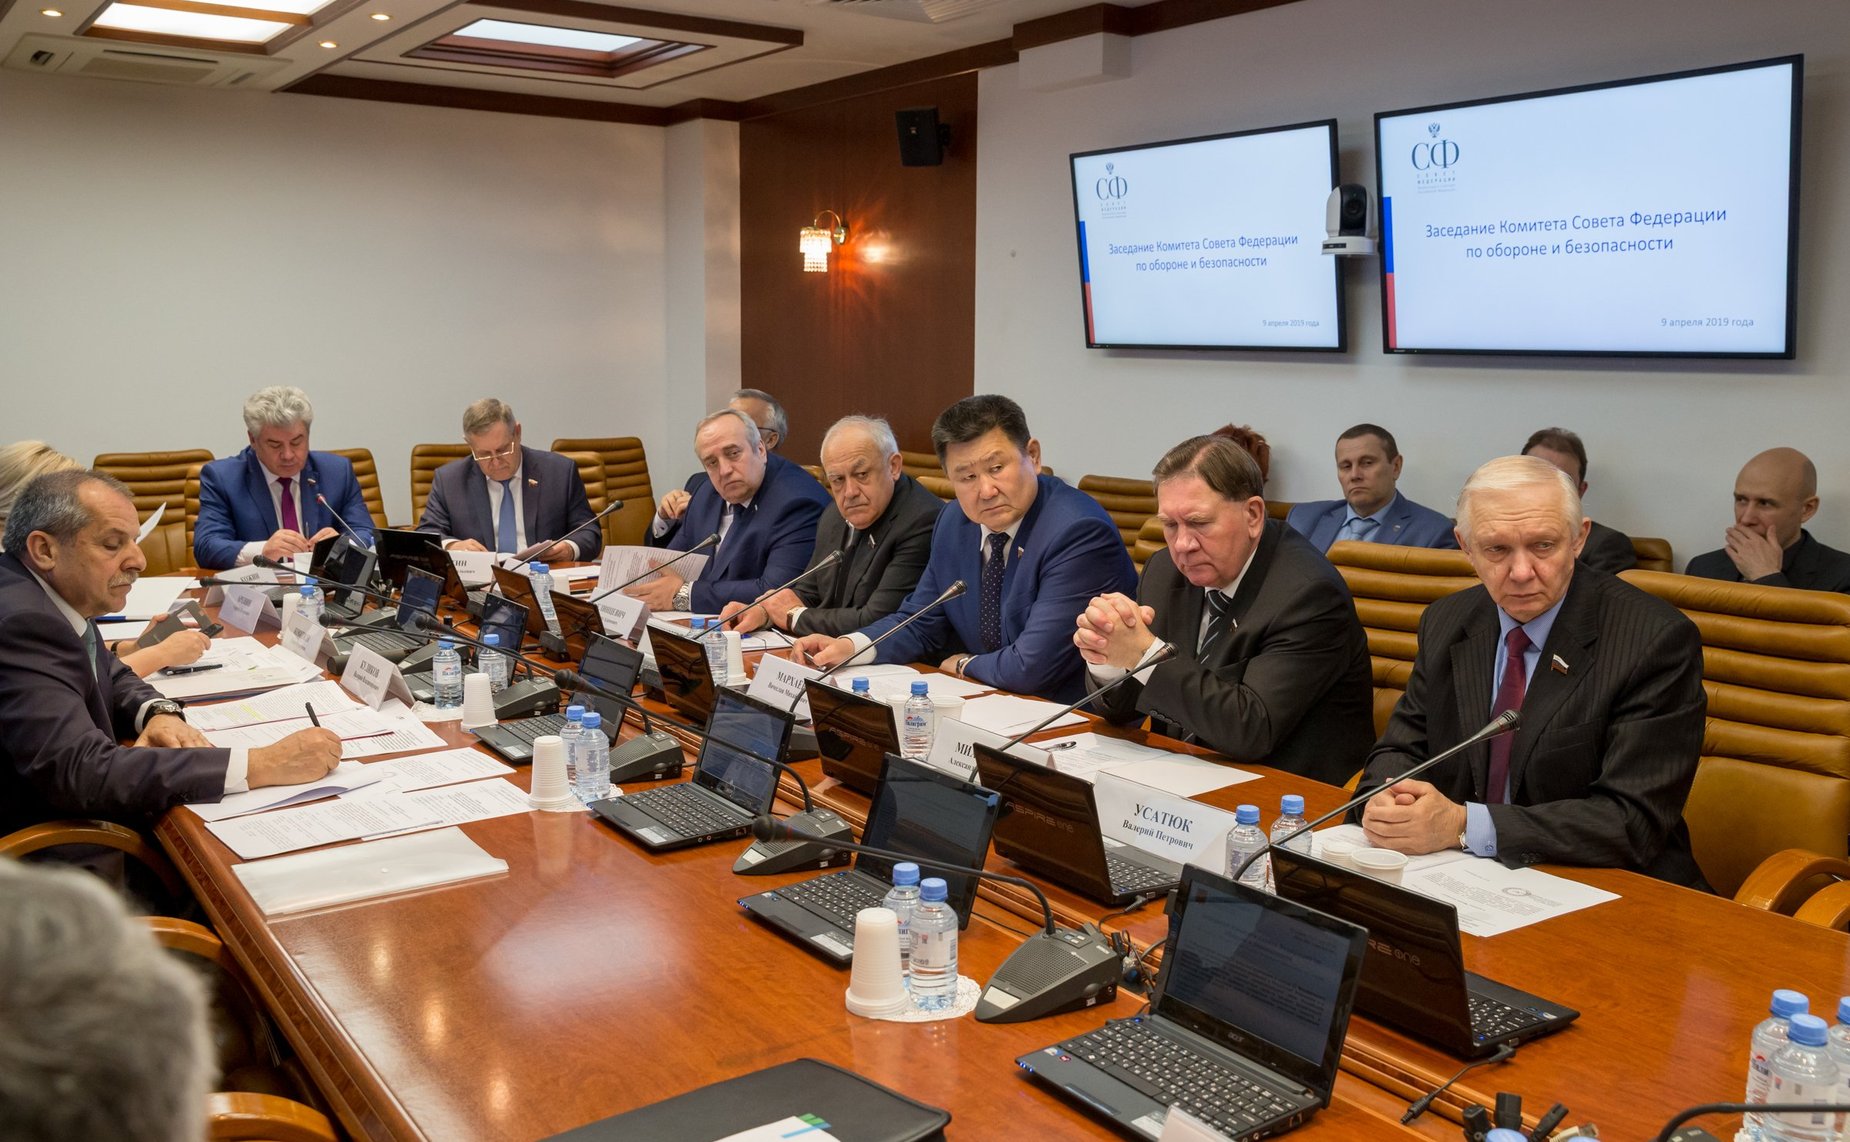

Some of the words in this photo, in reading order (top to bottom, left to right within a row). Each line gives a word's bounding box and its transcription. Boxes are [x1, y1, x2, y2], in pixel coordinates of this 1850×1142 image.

[1411, 139, 1460, 170] СФ
[1096, 176, 1128, 200] СФ
[1426, 223, 1496, 239] Заседание
[1499, 219, 1567, 234] Комитета
[1572, 215, 1625, 230] Совета
[1630, 209, 1727, 228] Федерации
[1108, 243, 1155, 255] Заседание
[1156, 240, 1200, 252] Комитета
[1202, 237, 1236, 250] Совета
[1238, 235, 1298, 249] Федерации
[1466, 247, 1482, 258] по
[1486, 242, 1547, 259] обороне
[1552, 244, 1560, 254] и
[1565, 238, 1673, 254] безопасности
[1136, 261, 1147, 272] по
[1149, 258, 1189, 272] обороне
[1191, 259, 1197, 269] и
[1200, 256, 1267, 269] безопасности
[1660, 318, 1667, 327] 9
[1669, 319, 1703, 328] апреля
[1705, 317, 1729, 327] 2019
[1731, 319, 1754, 328] года
[1133, 802, 1194, 833] УСАТЮК
[1122, 819, 1154, 837] Валерий
[1155, 830, 1194, 850] Петрович
